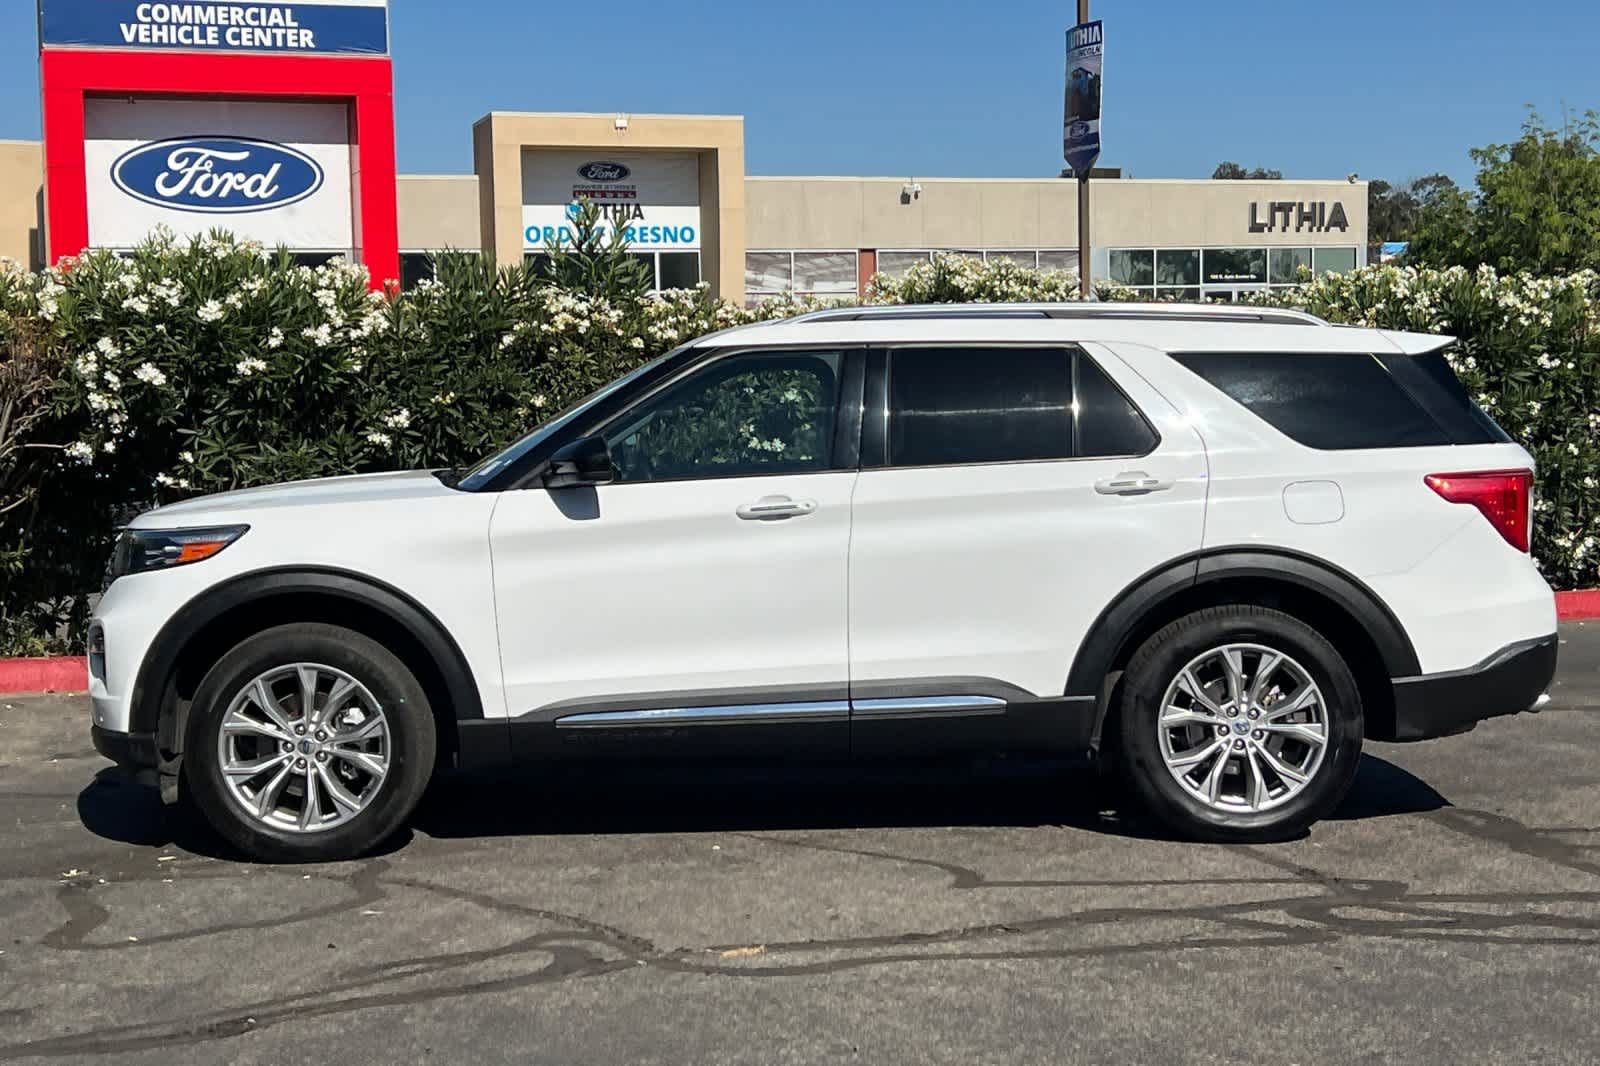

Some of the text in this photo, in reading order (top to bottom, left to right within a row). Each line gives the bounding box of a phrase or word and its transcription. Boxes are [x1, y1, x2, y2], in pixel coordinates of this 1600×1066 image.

[135, 3, 298, 28] COMMERCIAL
[119, 23, 315, 48] VEHICLE CENTER
[154, 147, 282, 199] Ford
[587, 164, 621, 178] Ford
[1248, 201, 1350, 233] LITHIA
[613, 226, 696, 243] RESNO
